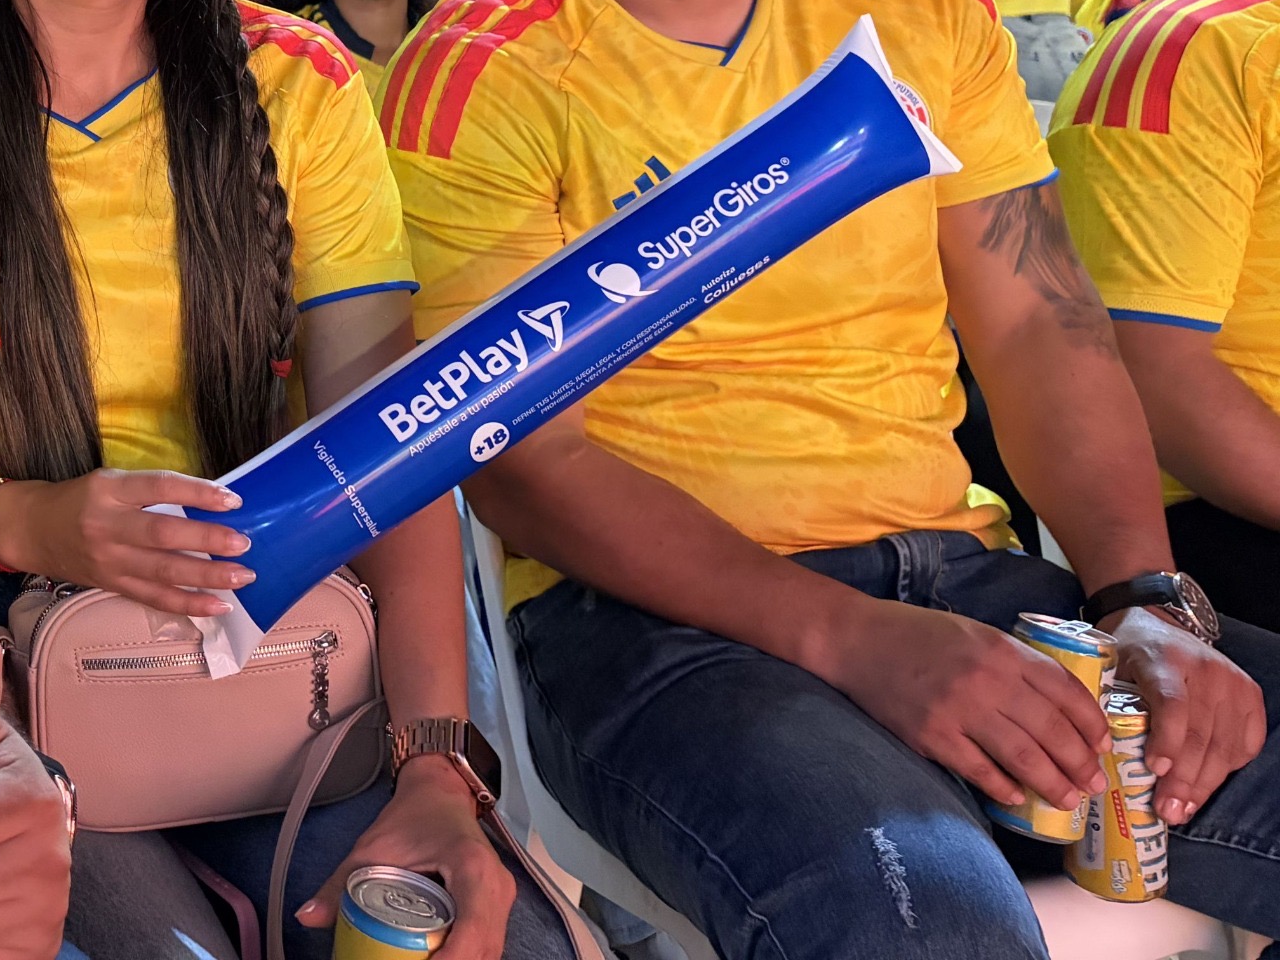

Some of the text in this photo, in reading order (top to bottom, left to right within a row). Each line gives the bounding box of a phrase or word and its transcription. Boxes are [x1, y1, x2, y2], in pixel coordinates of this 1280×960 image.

[701, 266, 736, 293] Autoriza
[703, 255, 770, 303] Coljuegos
[378, 328, 530, 443] BetPlay
[511, 406, 536, 426] DEFINE
[534, 396, 550, 409] TUS
[575, 365, 596, 382] JUEGA
[595, 352, 616, 368] LEGAL
[621, 337, 636, 350] CON
[584, 366, 607, 383] VENTA
[408, 377, 514, 456] Apuéstale a tu pasión
[473, 428, 508, 455] +18
[313, 440, 380, 537] Vigilado Supersalud
